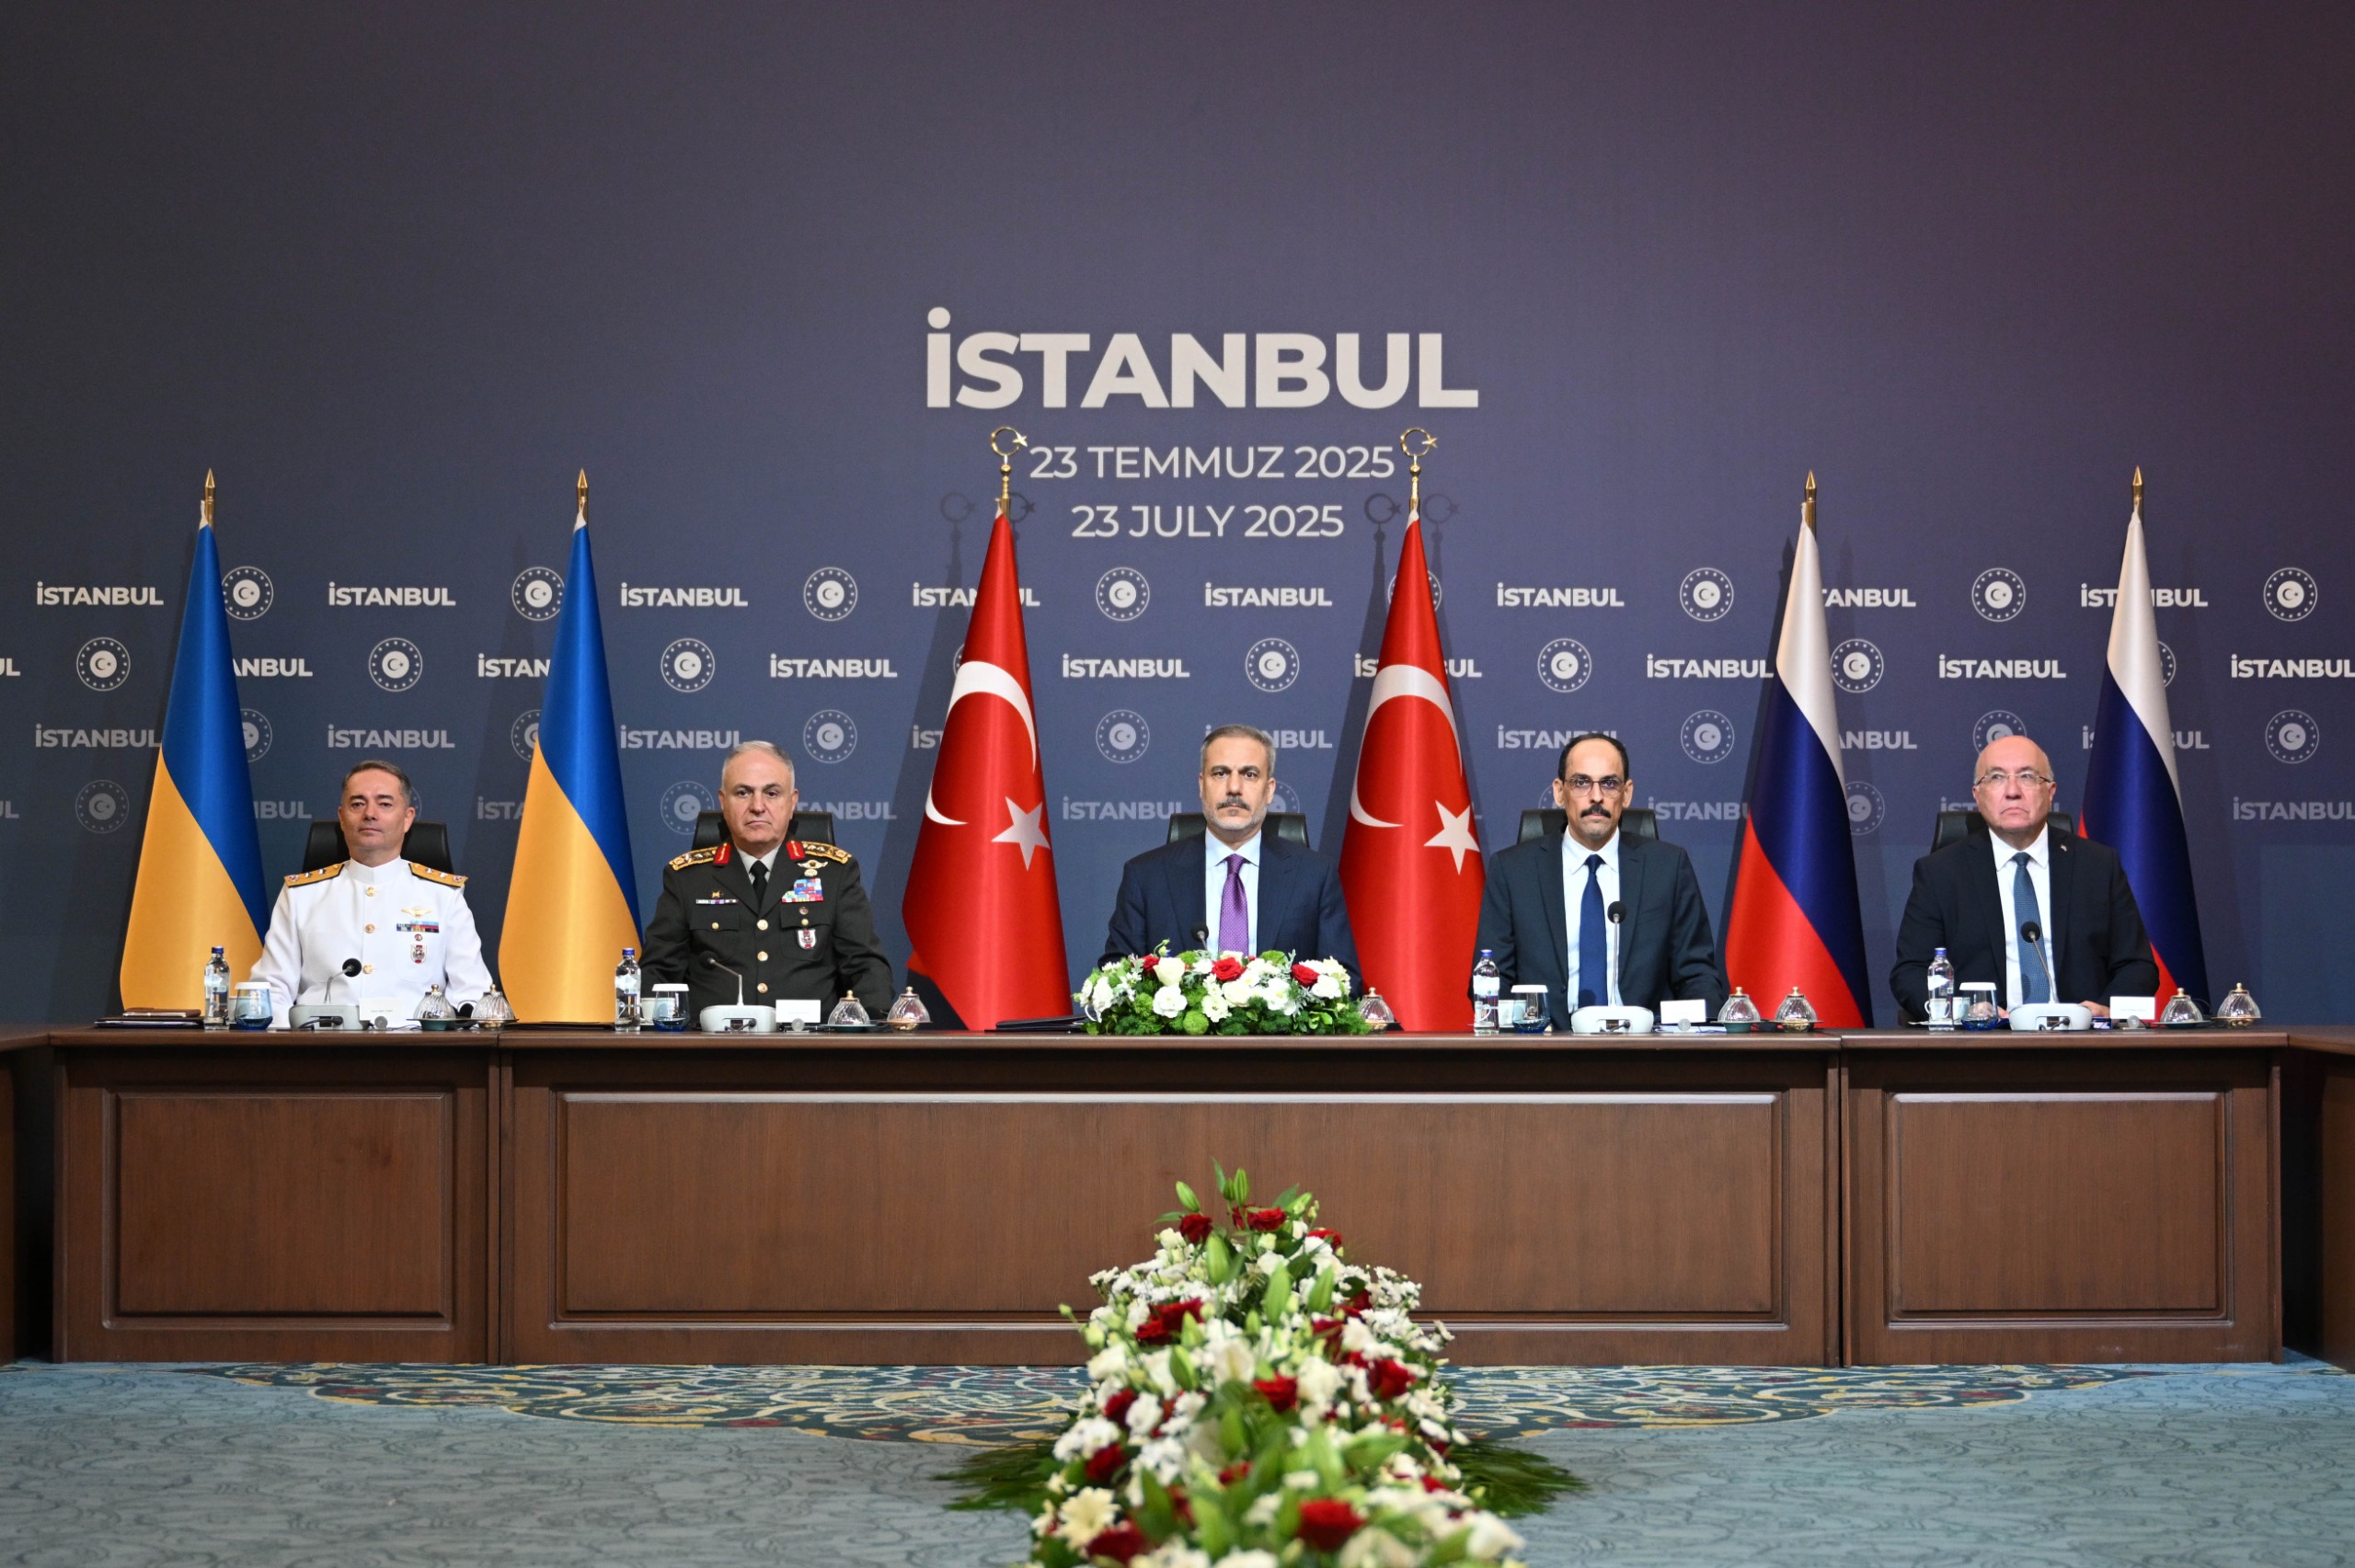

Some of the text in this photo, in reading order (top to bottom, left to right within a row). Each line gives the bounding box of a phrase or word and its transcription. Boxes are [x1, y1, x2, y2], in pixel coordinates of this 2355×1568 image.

[926, 306, 1479, 409] İSTANBUL
[1029, 446, 1395, 478] 23 TEMMUZ 2025
[1071, 505, 1344, 537] 23 JULY 2025
[37, 581, 164, 606] İSTANBUL
[328, 581, 456, 606] İSTANBUL
[621, 582, 748, 607] İSTANBUL
[1205, 582, 1333, 607] İSTANBUL
[1498, 582, 1625, 607] İSTANBUL
[2081, 583, 2209, 607] İSTBUL
[478, 654, 551, 677] İSTAN
[770, 654, 898, 678] İSTANBUL
[1063, 654, 1189, 678] İSTANBUL
[1647, 654, 1774, 678] İSTANBUL
[1939, 654, 2066, 679] İSTANBUL
[327, 725, 455, 749] İSTANBUL
